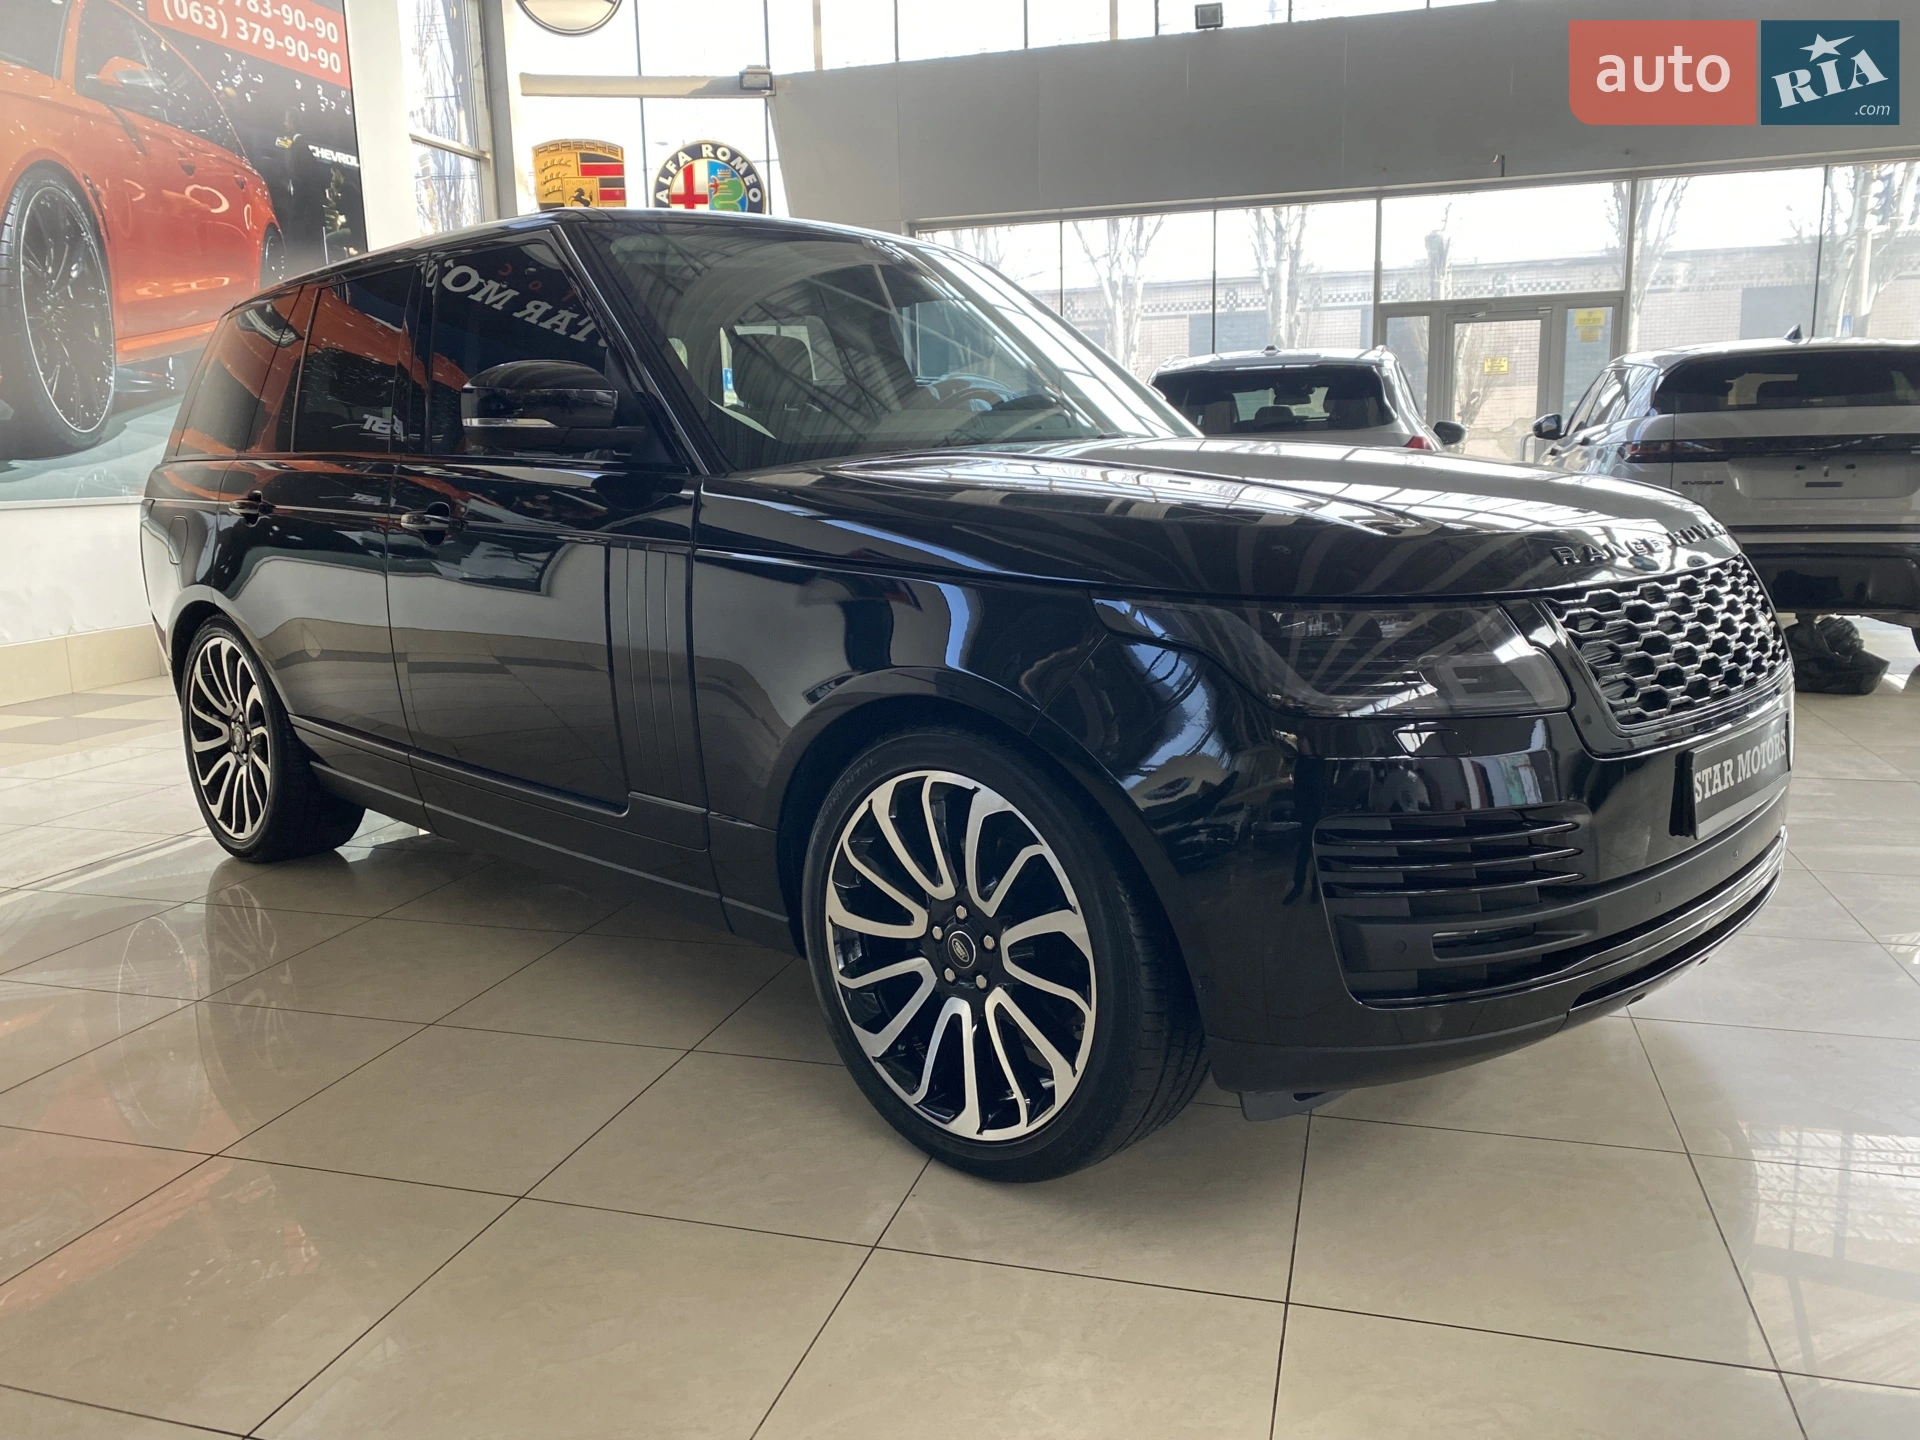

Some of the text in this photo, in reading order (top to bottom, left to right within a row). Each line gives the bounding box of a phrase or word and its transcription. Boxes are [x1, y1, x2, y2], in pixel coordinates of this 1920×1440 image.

[235, 17, 342, 74] 379-90-90
[535, 141, 620, 158] PORSCHE
[655, 143, 763, 205] ALFA ROMEO
[1551, 521, 1728, 567] RANGE ROVER
[1694, 728, 1787, 804] STAR MOTORS
